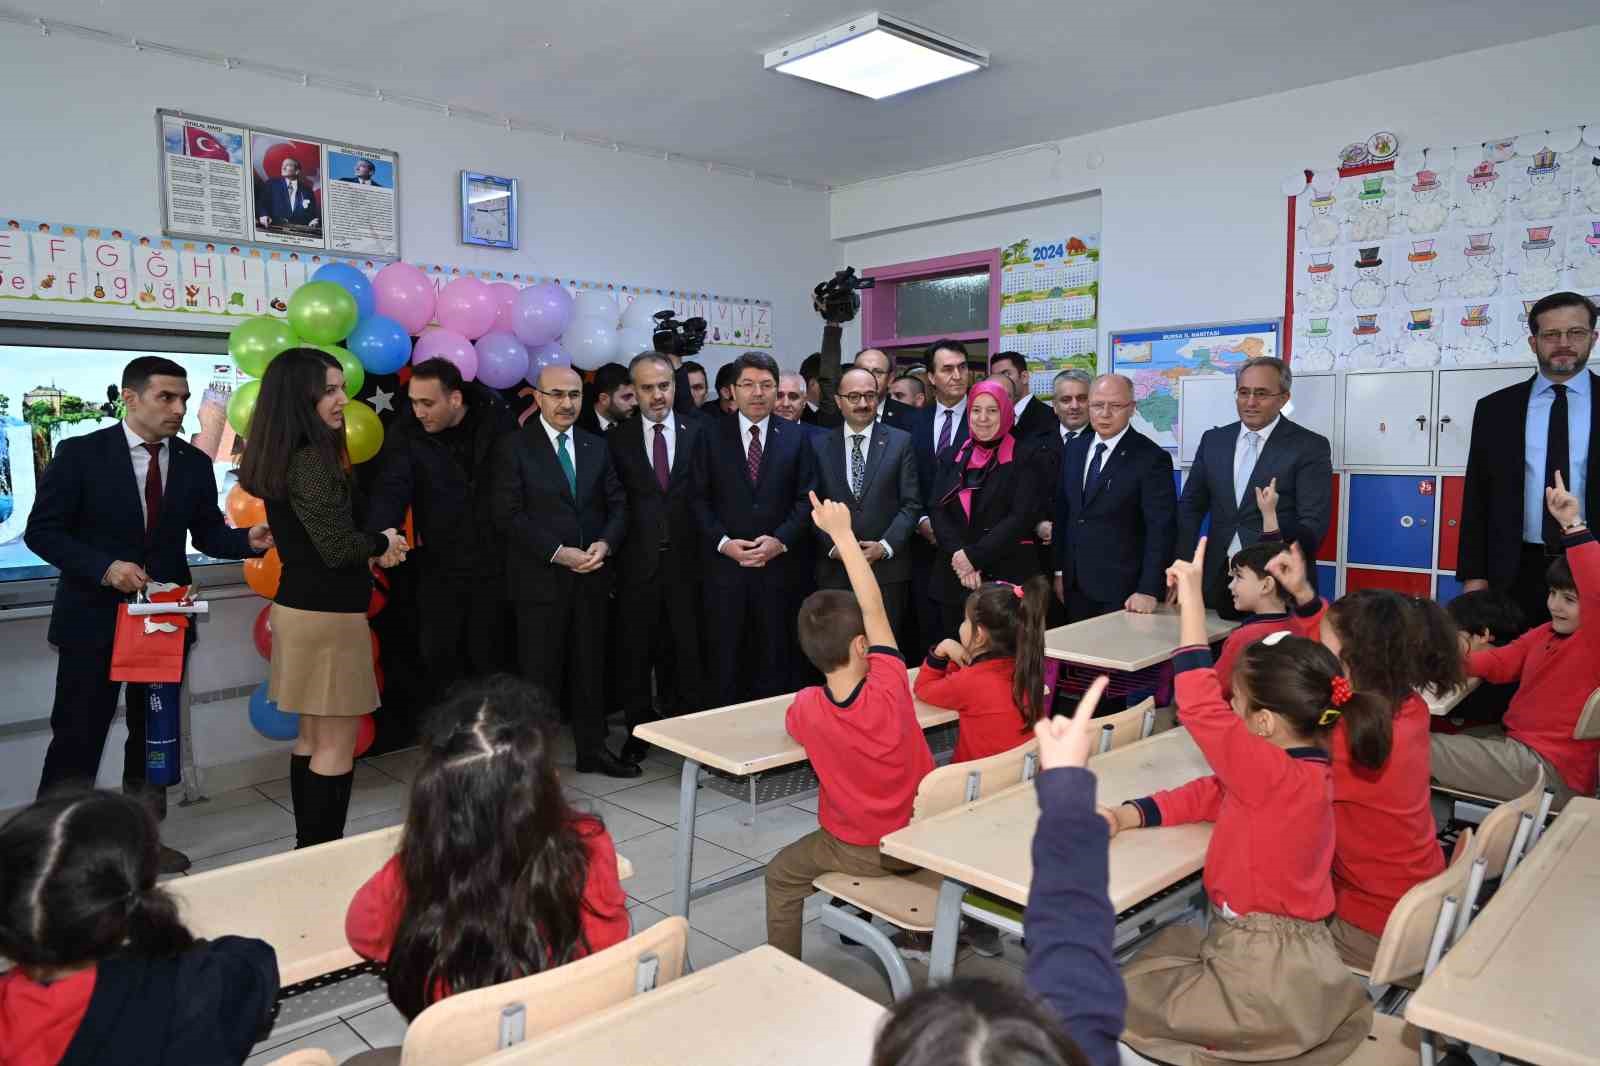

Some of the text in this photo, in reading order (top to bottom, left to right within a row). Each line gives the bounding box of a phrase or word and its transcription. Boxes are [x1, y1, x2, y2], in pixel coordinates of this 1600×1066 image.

[50, 239, 66, 263] F
[95, 244, 119, 267] G
[146, 251, 168, 279] Ğ
[193, 255, 211, 279] H
[1033, 243, 1064, 262] 2024
[11, 276, 25, 290] e
[67, 272, 77, 295] f
[113, 276, 128, 299] g
[162, 283, 175, 309] ğ
[207, 286, 221, 308] h
[758, 307, 769, 325] Z
